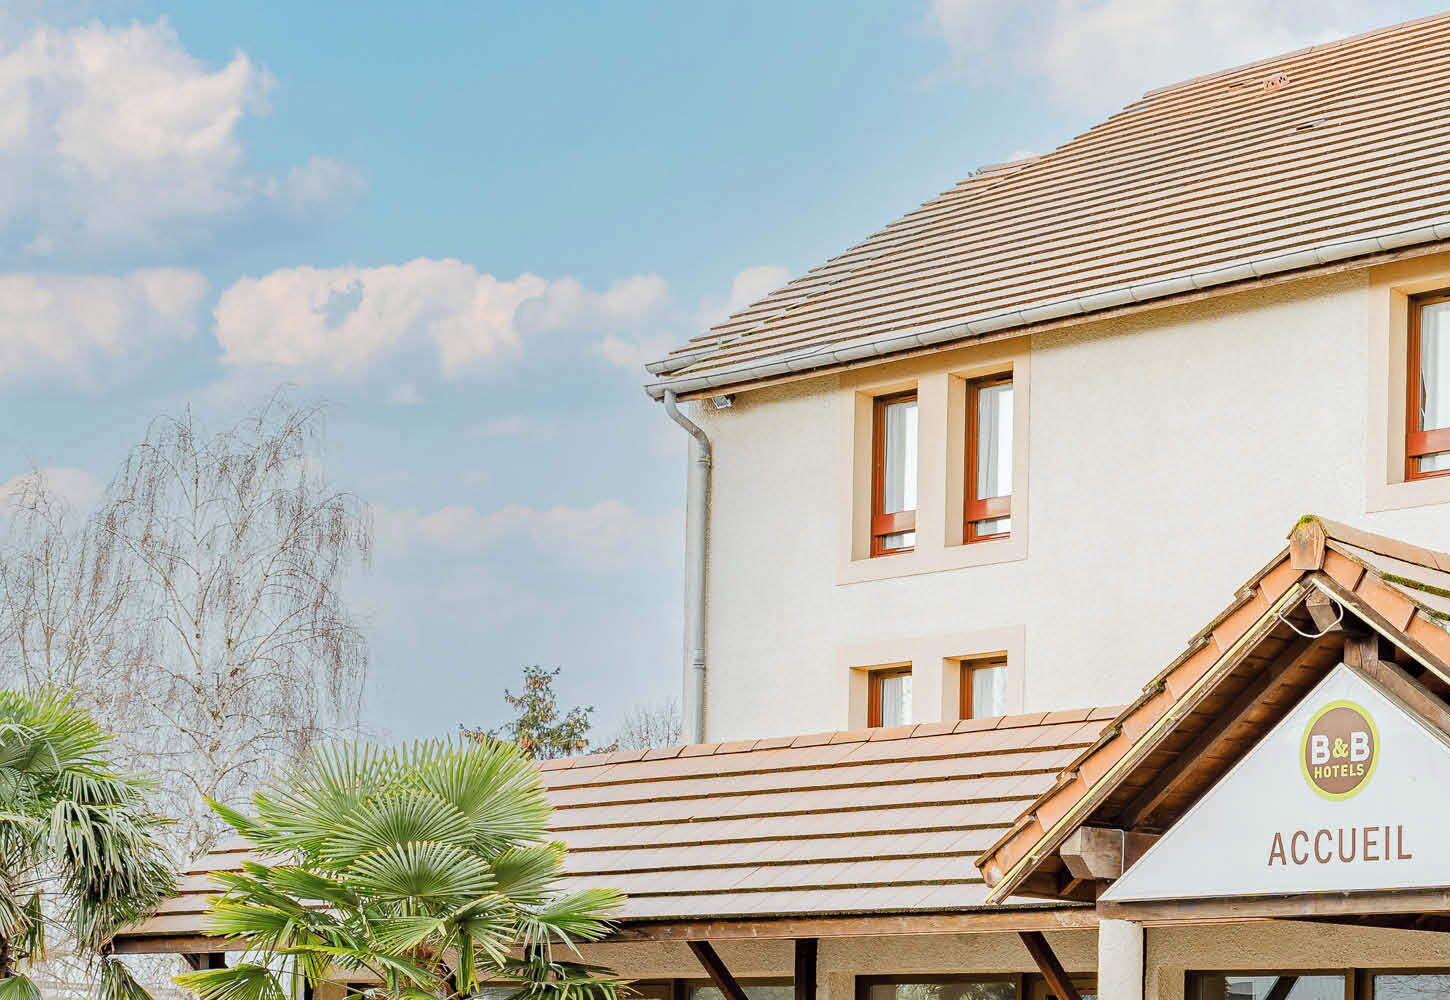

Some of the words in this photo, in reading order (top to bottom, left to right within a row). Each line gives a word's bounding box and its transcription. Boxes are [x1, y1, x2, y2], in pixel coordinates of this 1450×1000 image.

[1311, 731, 1370, 765] B&B
[1314, 763, 1365, 779] HOTELS
[1267, 824, 1412, 866] ACCUEIL
